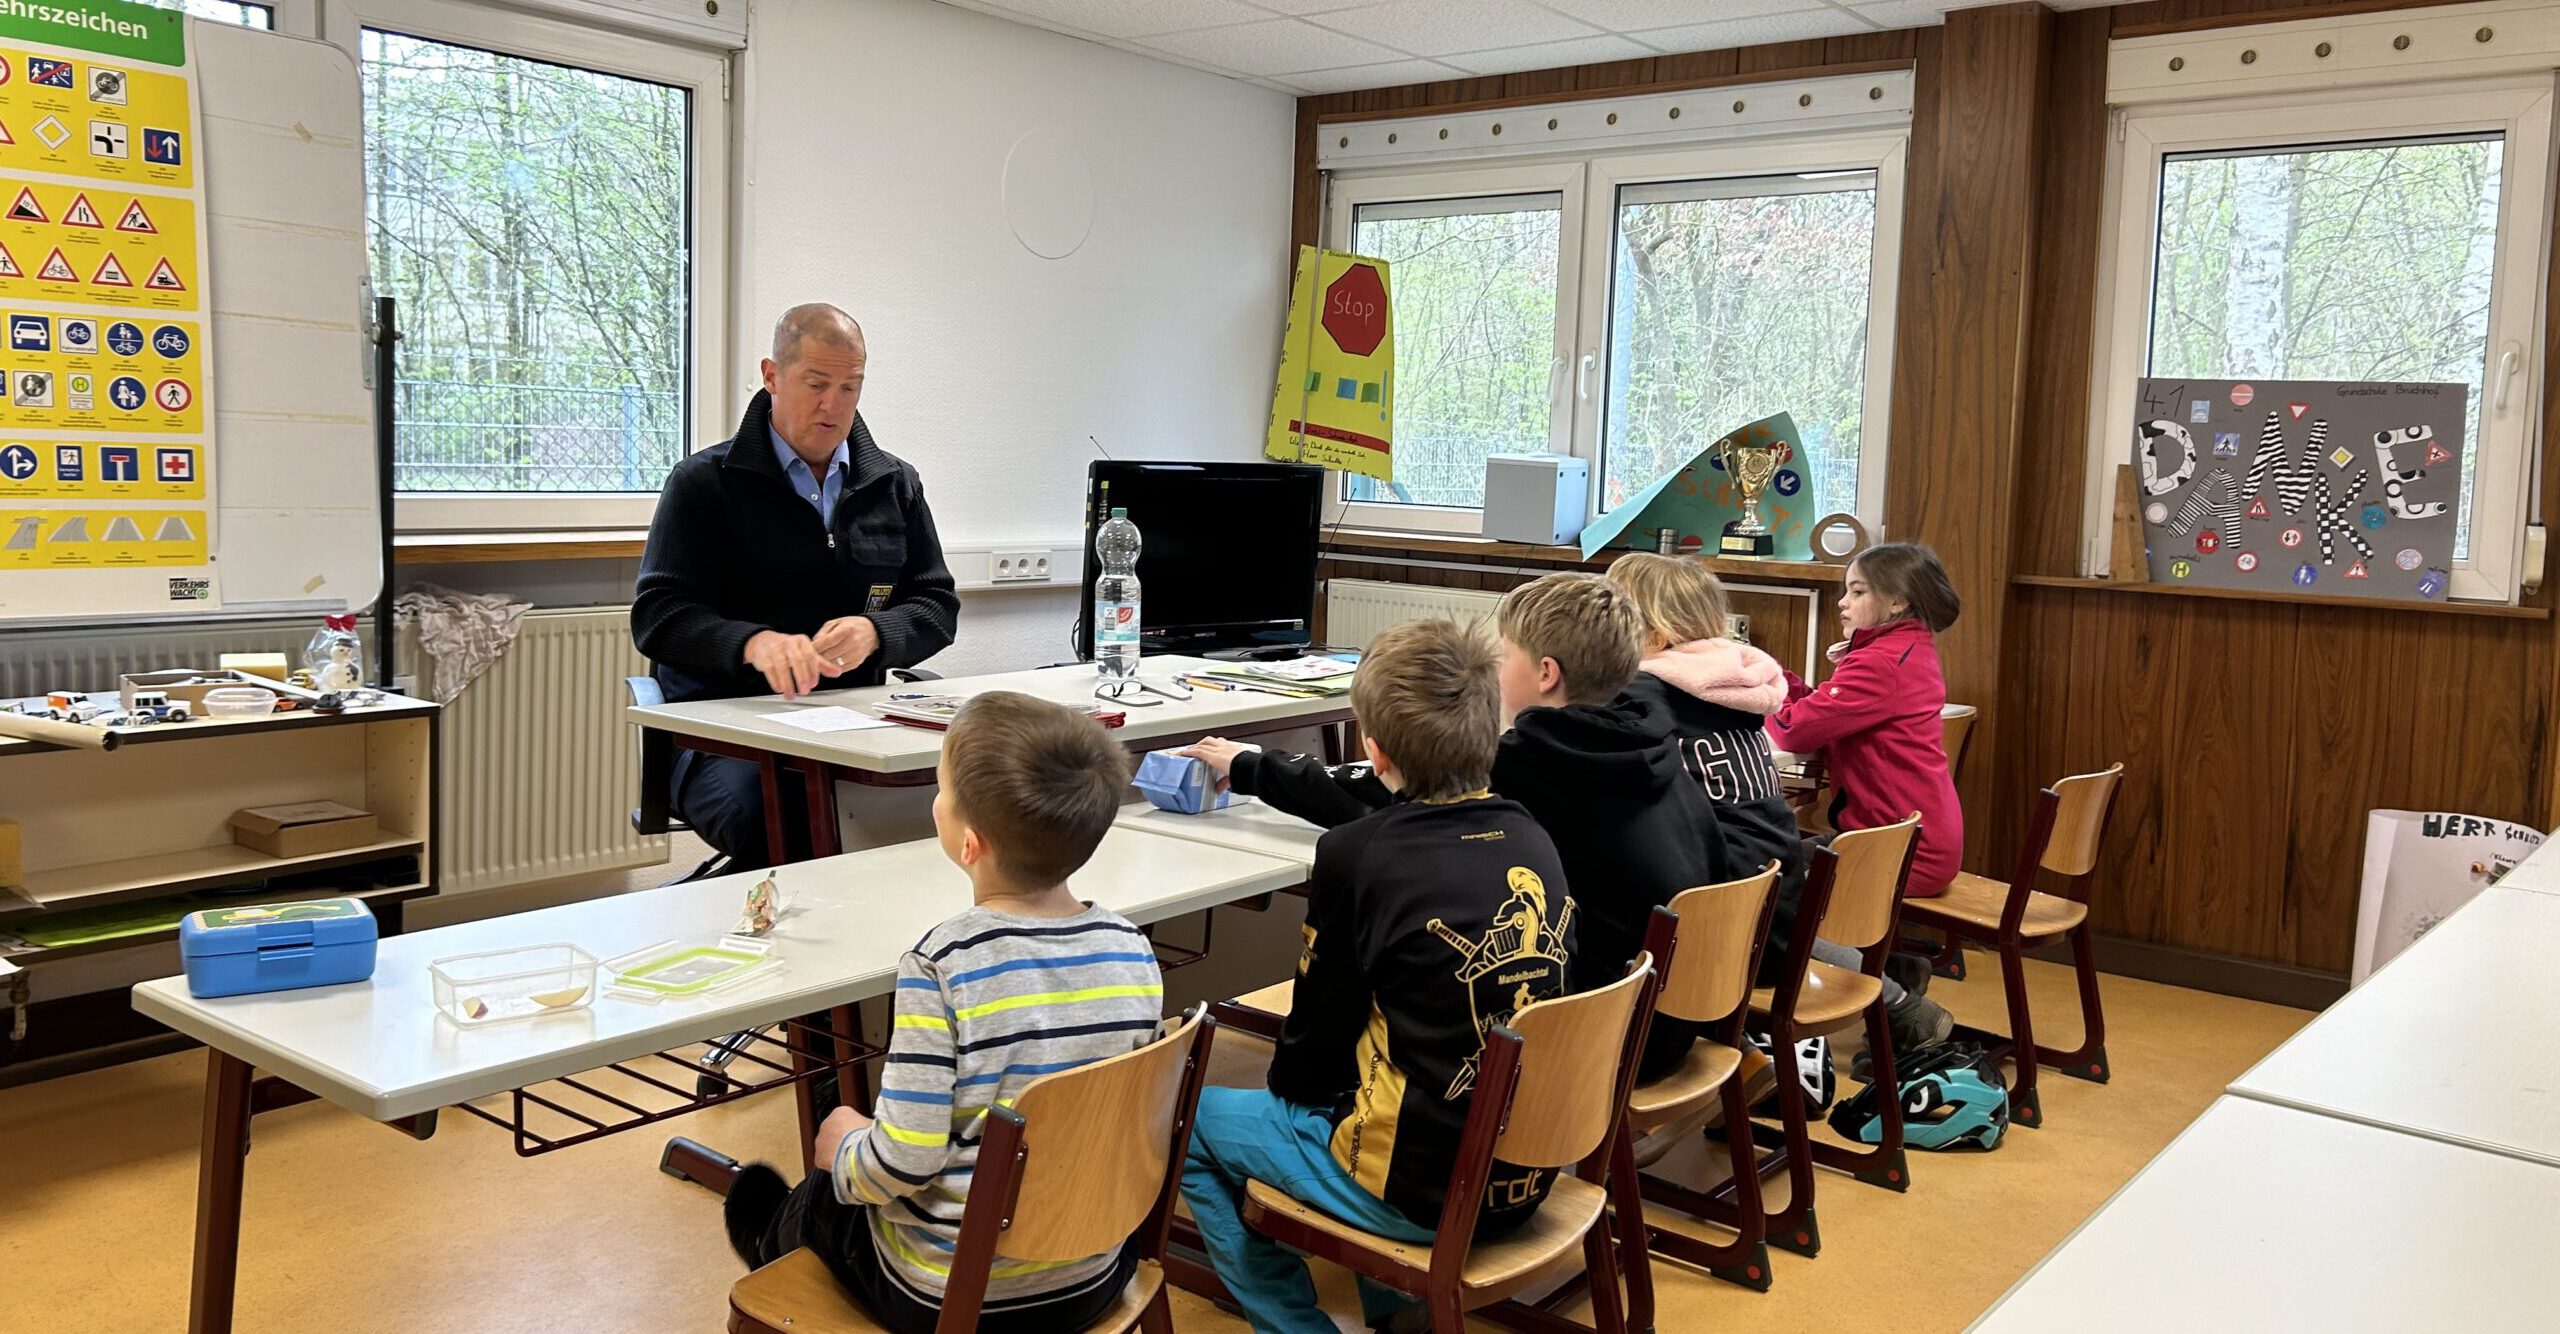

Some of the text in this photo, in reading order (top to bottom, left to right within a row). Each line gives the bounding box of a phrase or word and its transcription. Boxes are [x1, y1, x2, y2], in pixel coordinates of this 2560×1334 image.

[1334, 290, 1374, 326] Stop
[2337, 385, 2387, 396] Grundschule
[2144, 383, 2184, 417] 4.1
[170, 581, 209, 589] VERKEHRS
[170, 589, 197, 597] WACHT
[2422, 814, 2495, 838] HERR
